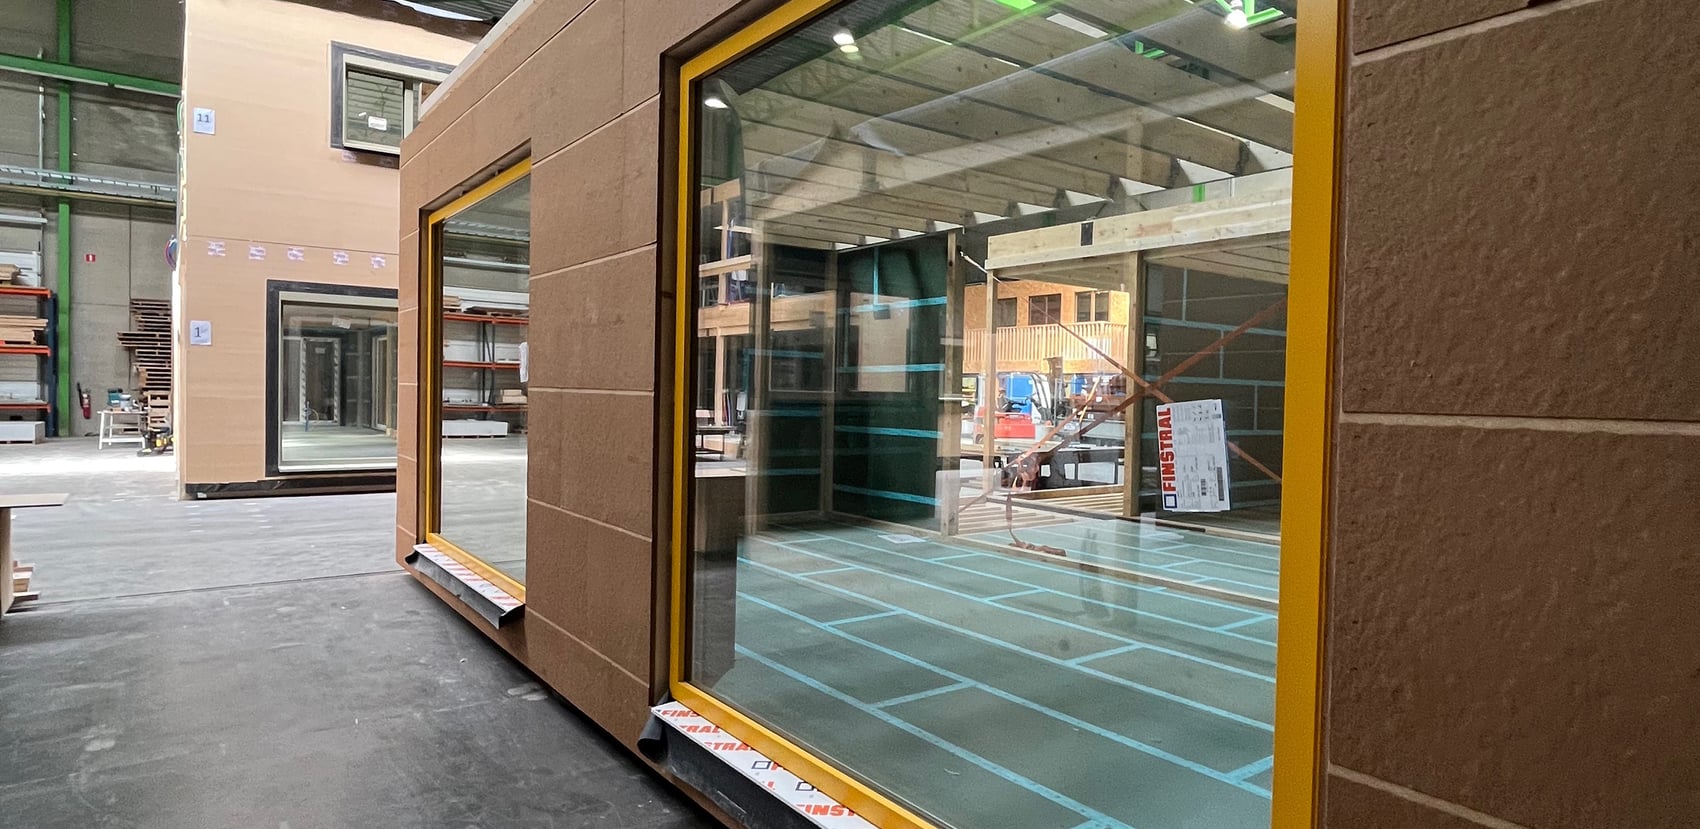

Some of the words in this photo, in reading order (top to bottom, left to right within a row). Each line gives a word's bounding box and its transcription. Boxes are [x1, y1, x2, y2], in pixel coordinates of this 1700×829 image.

[197, 113, 209, 123] 11
[1158, 407, 1177, 492] FINSTRAL
[704, 742, 755, 751] STRA
